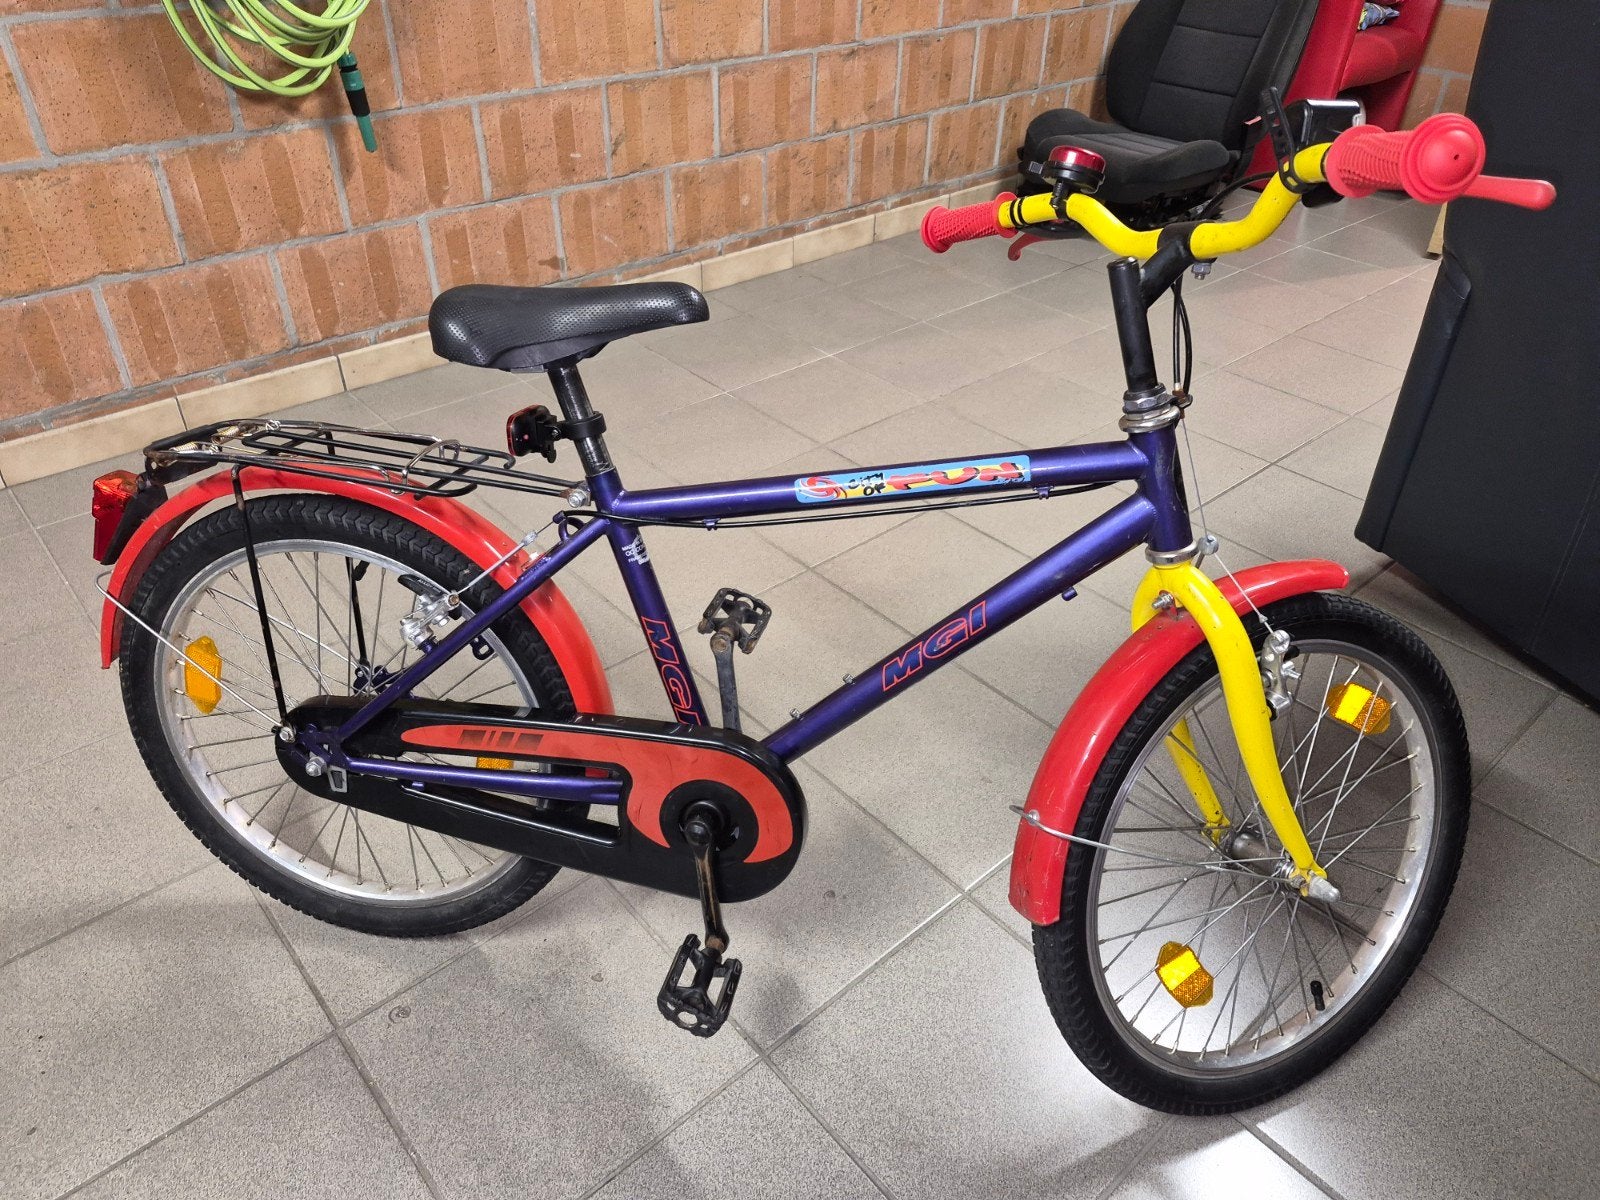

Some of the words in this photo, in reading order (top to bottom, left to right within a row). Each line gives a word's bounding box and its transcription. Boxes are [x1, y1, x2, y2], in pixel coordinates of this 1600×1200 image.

[863, 482, 886, 497] OF
[886, 462, 1024, 490] FUN
[882, 600, 987, 692] MGI
